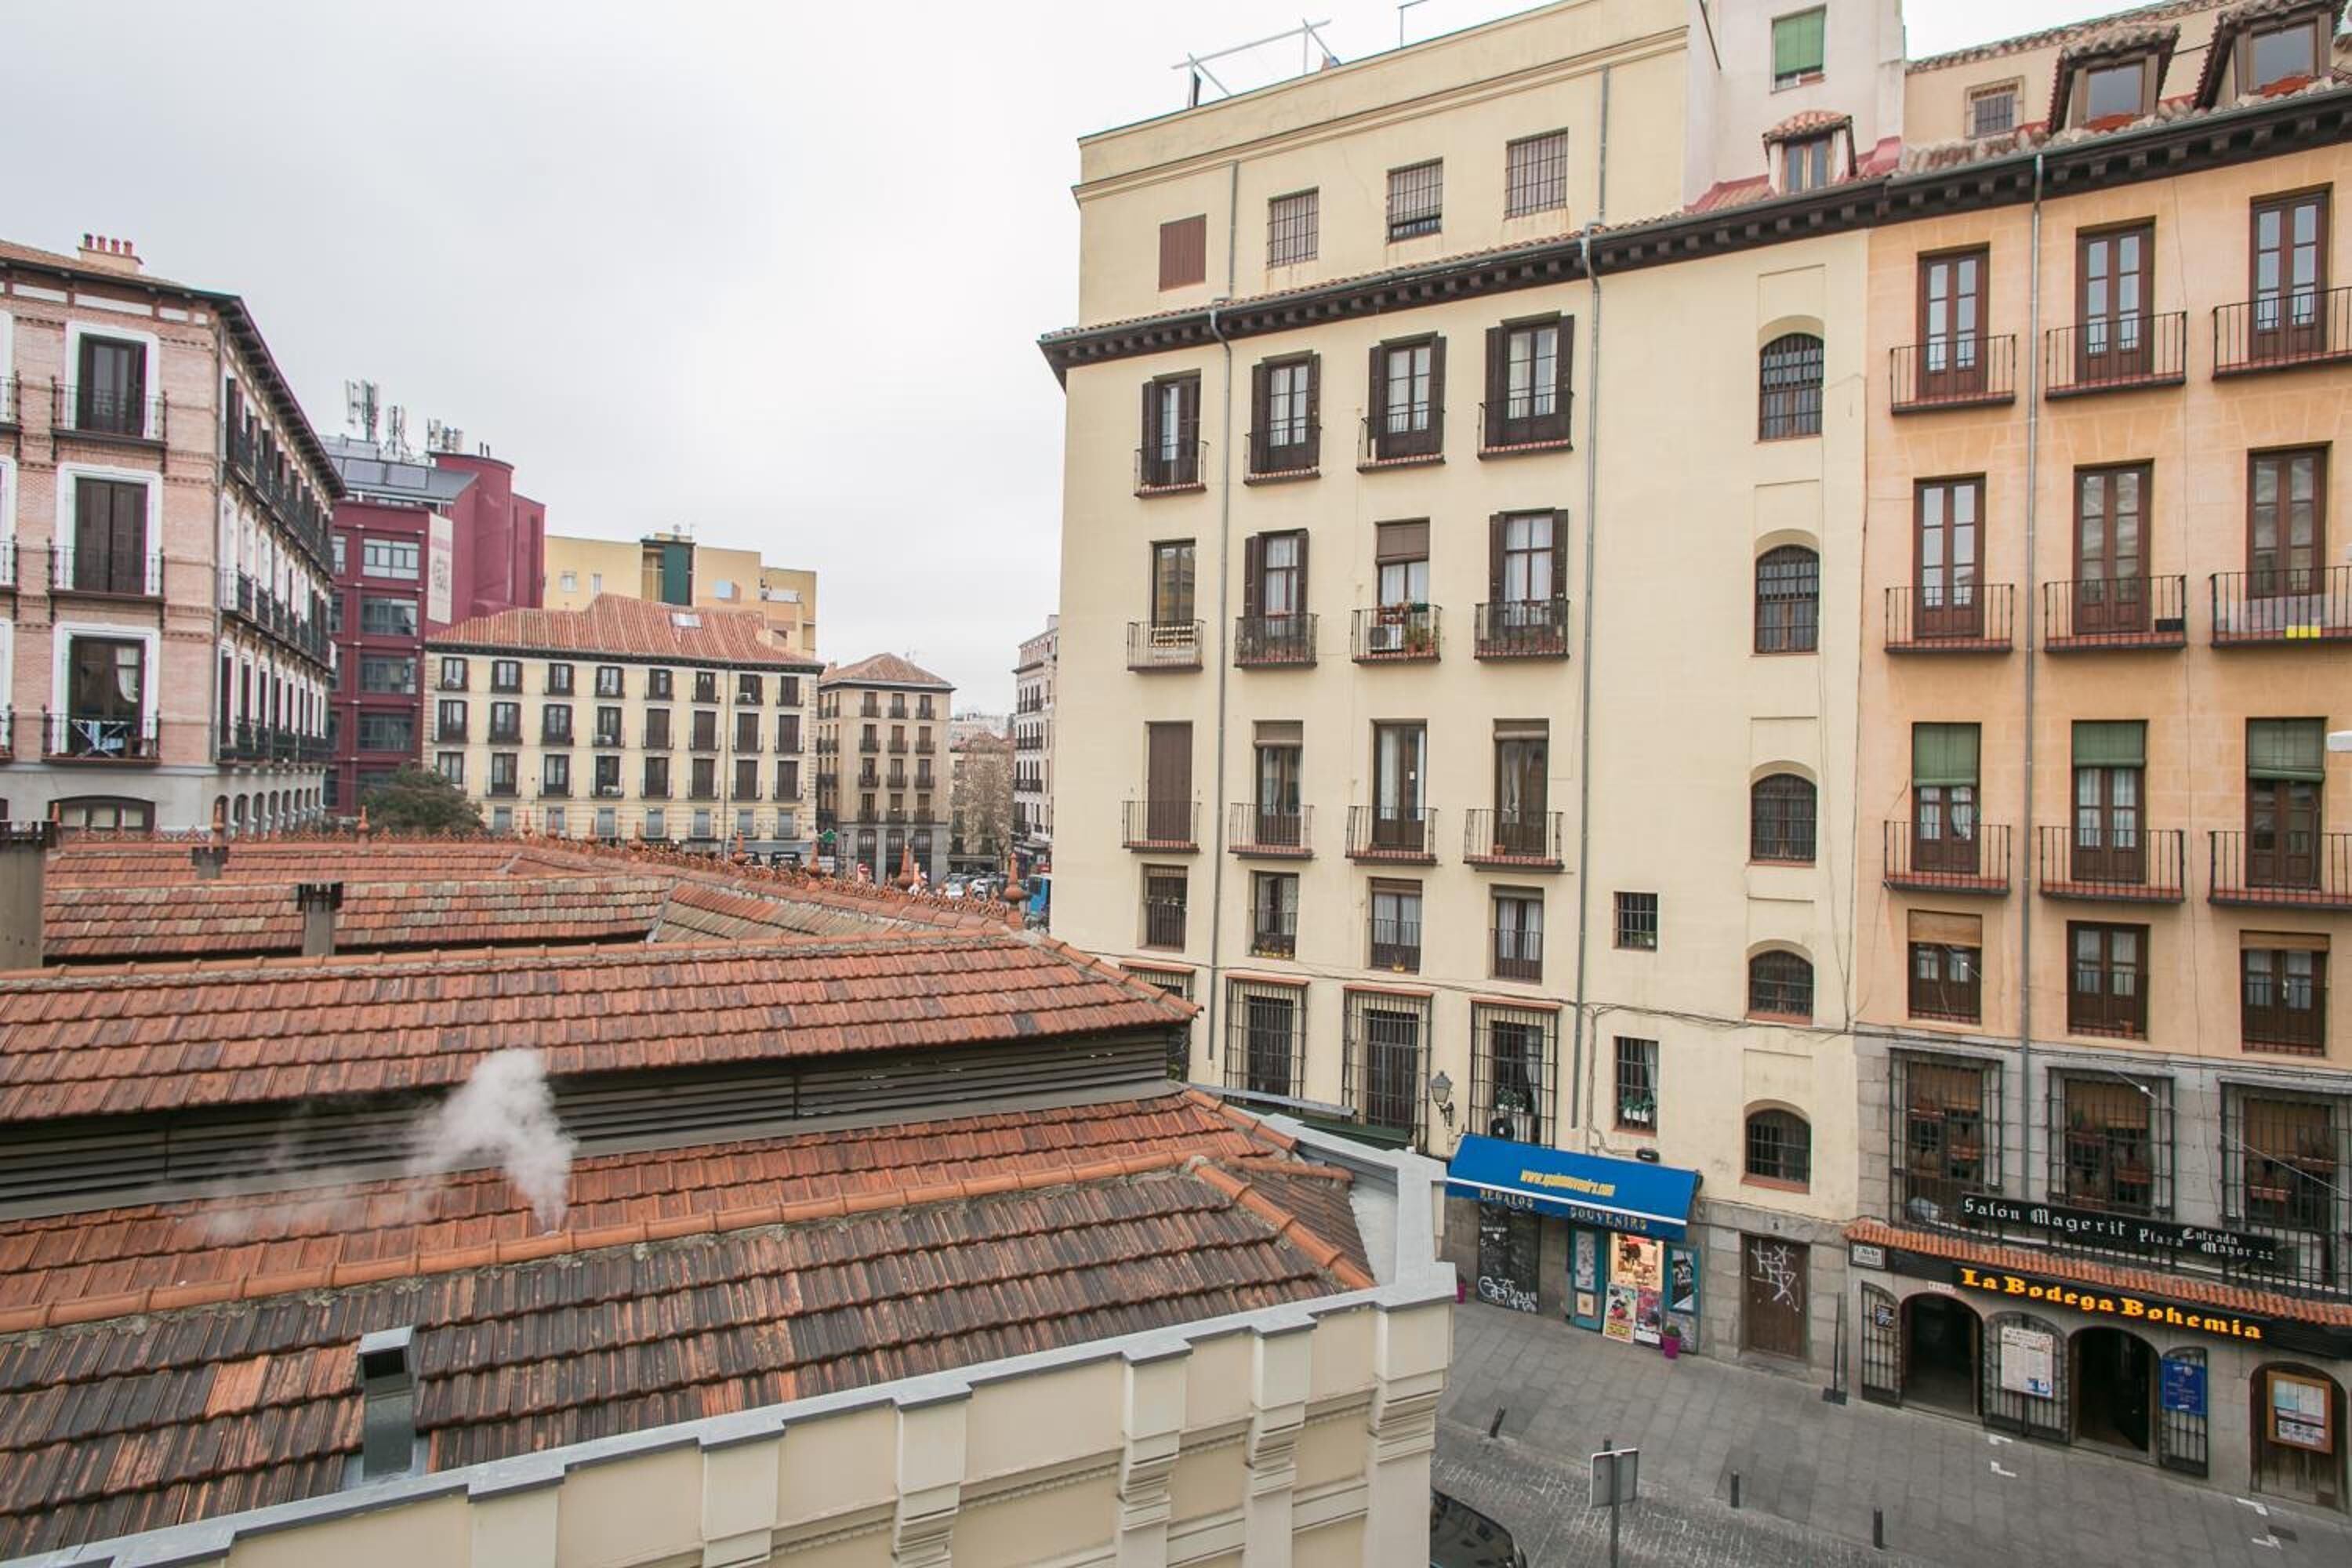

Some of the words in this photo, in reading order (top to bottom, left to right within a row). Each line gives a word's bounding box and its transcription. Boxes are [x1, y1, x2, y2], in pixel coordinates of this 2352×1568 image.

[1570, 1207, 1647, 1230] SOUVENIRS
[1963, 1197, 2020, 1221] Salón
[2030, 1207, 2126, 1236] Magerit
[2138, 1228, 2183, 1247] Plaza
[2201, 1241, 2252, 1258] Mayor
[2182, 1227, 2238, 1245] Entrada
[1961, 1268, 1998, 1290] La
[2003, 1276, 2114, 1312] Bodega
[2119, 1297, 2263, 1339] Bohemia
